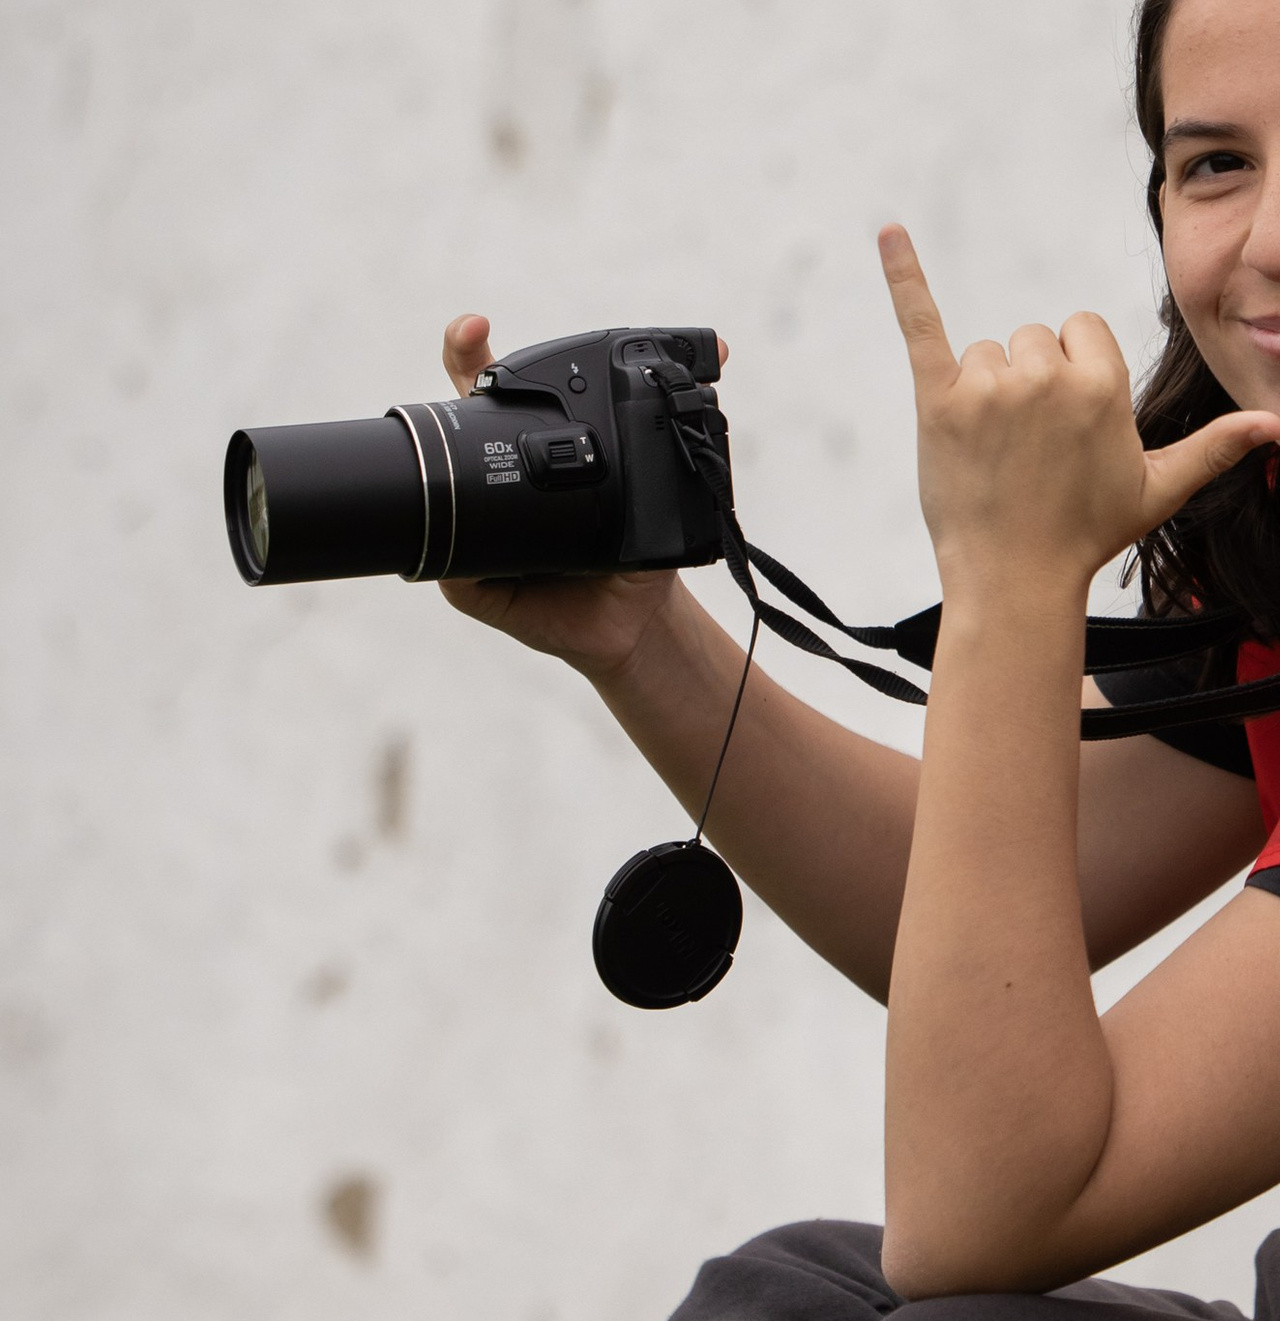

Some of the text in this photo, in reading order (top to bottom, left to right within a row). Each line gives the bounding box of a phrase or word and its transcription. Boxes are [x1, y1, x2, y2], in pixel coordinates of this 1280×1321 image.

[580, 436, 587, 444] T
[484, 441, 514, 455] 60x
[585, 454, 594, 462] W
[489, 461, 515, 469] WIDE
[504, 472, 519, 482] HD
